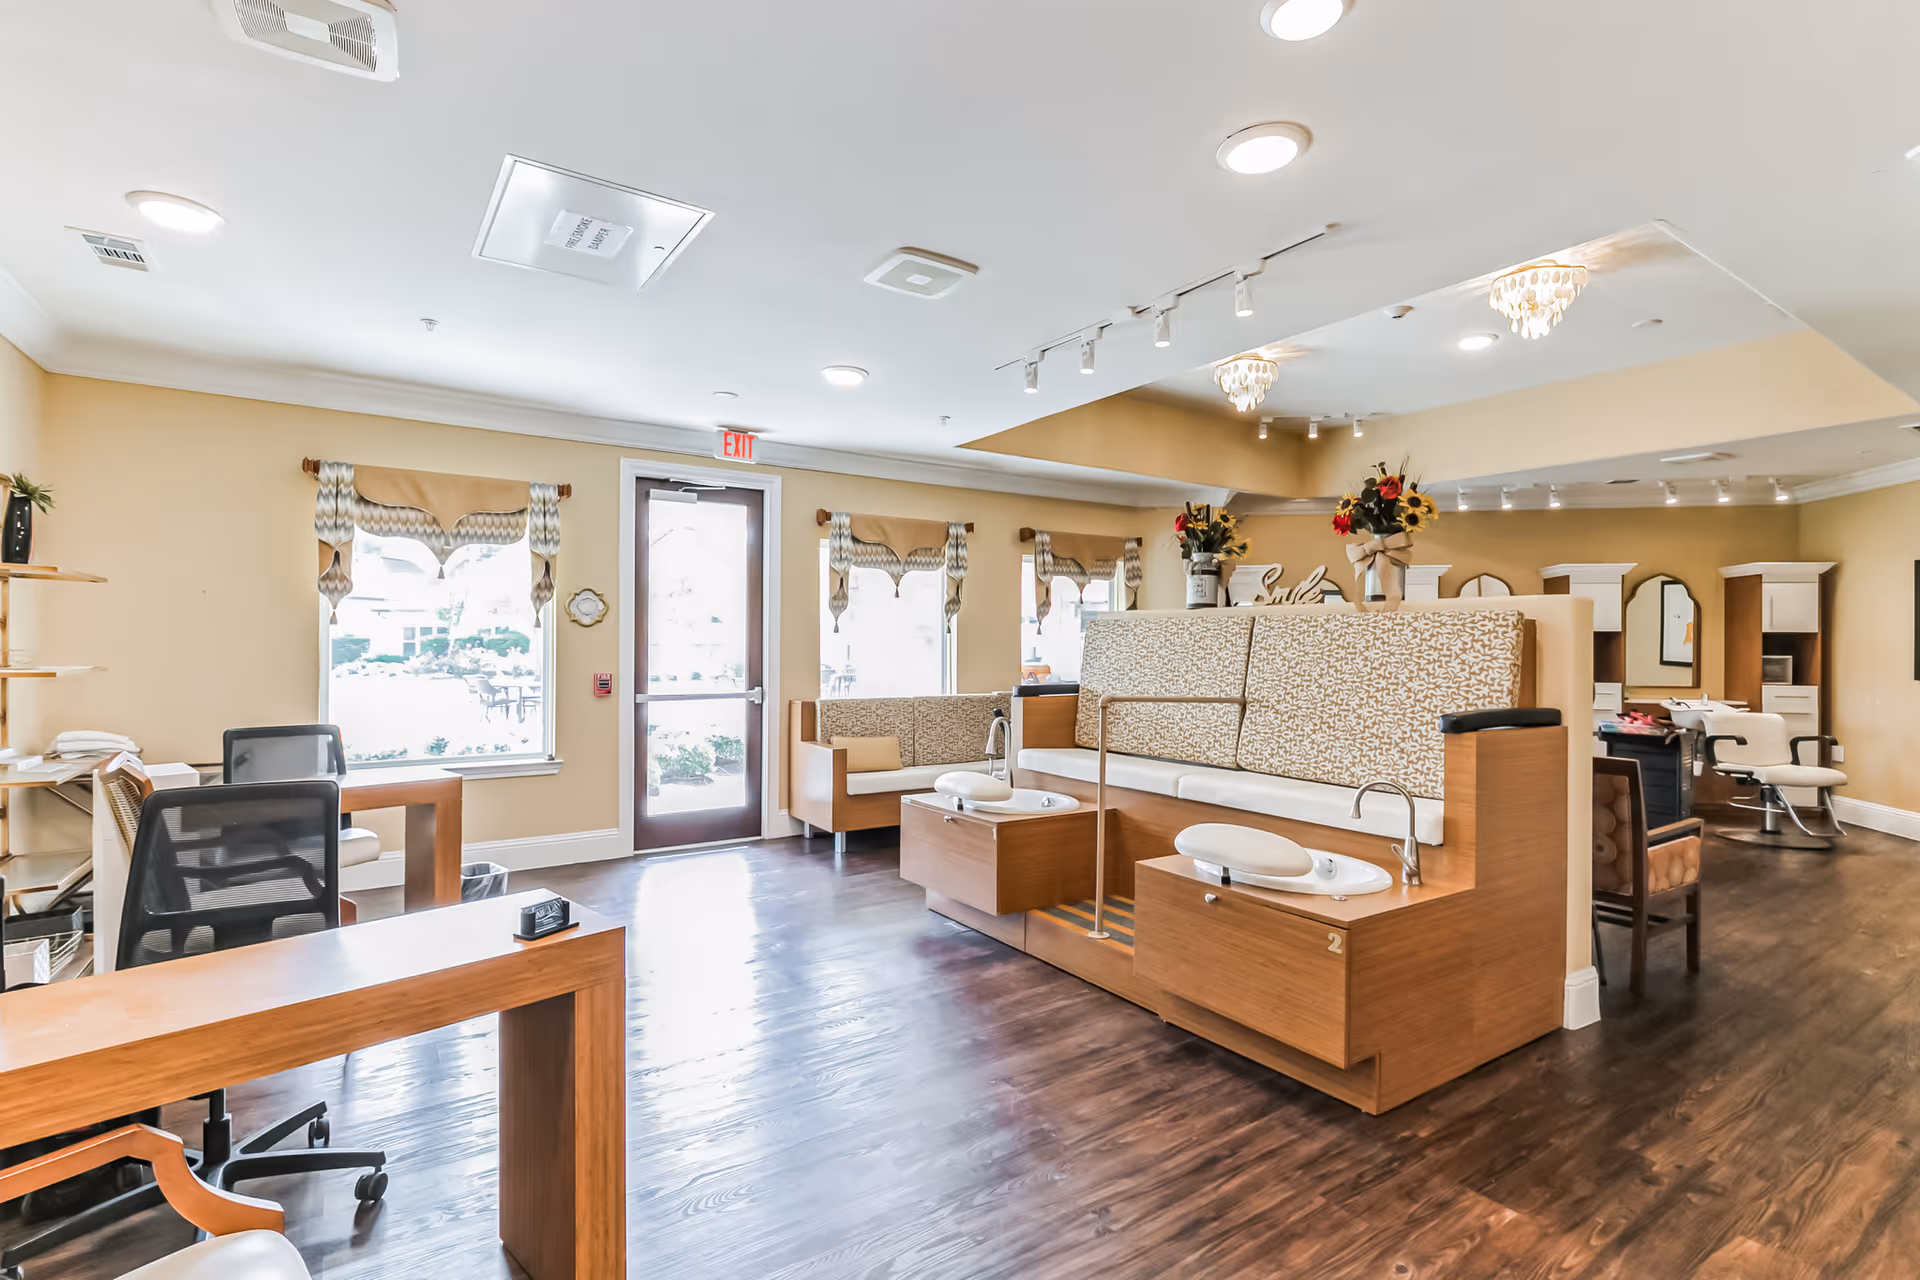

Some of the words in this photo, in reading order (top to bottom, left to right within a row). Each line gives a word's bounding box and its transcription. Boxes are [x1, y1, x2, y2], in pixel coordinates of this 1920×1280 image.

[565, 217, 593, 249] FIRE/SMOKE
[588, 227, 611, 250] DAMPER
[723, 431, 755, 460] EXIT
[1328, 932, 1343, 954] 2
